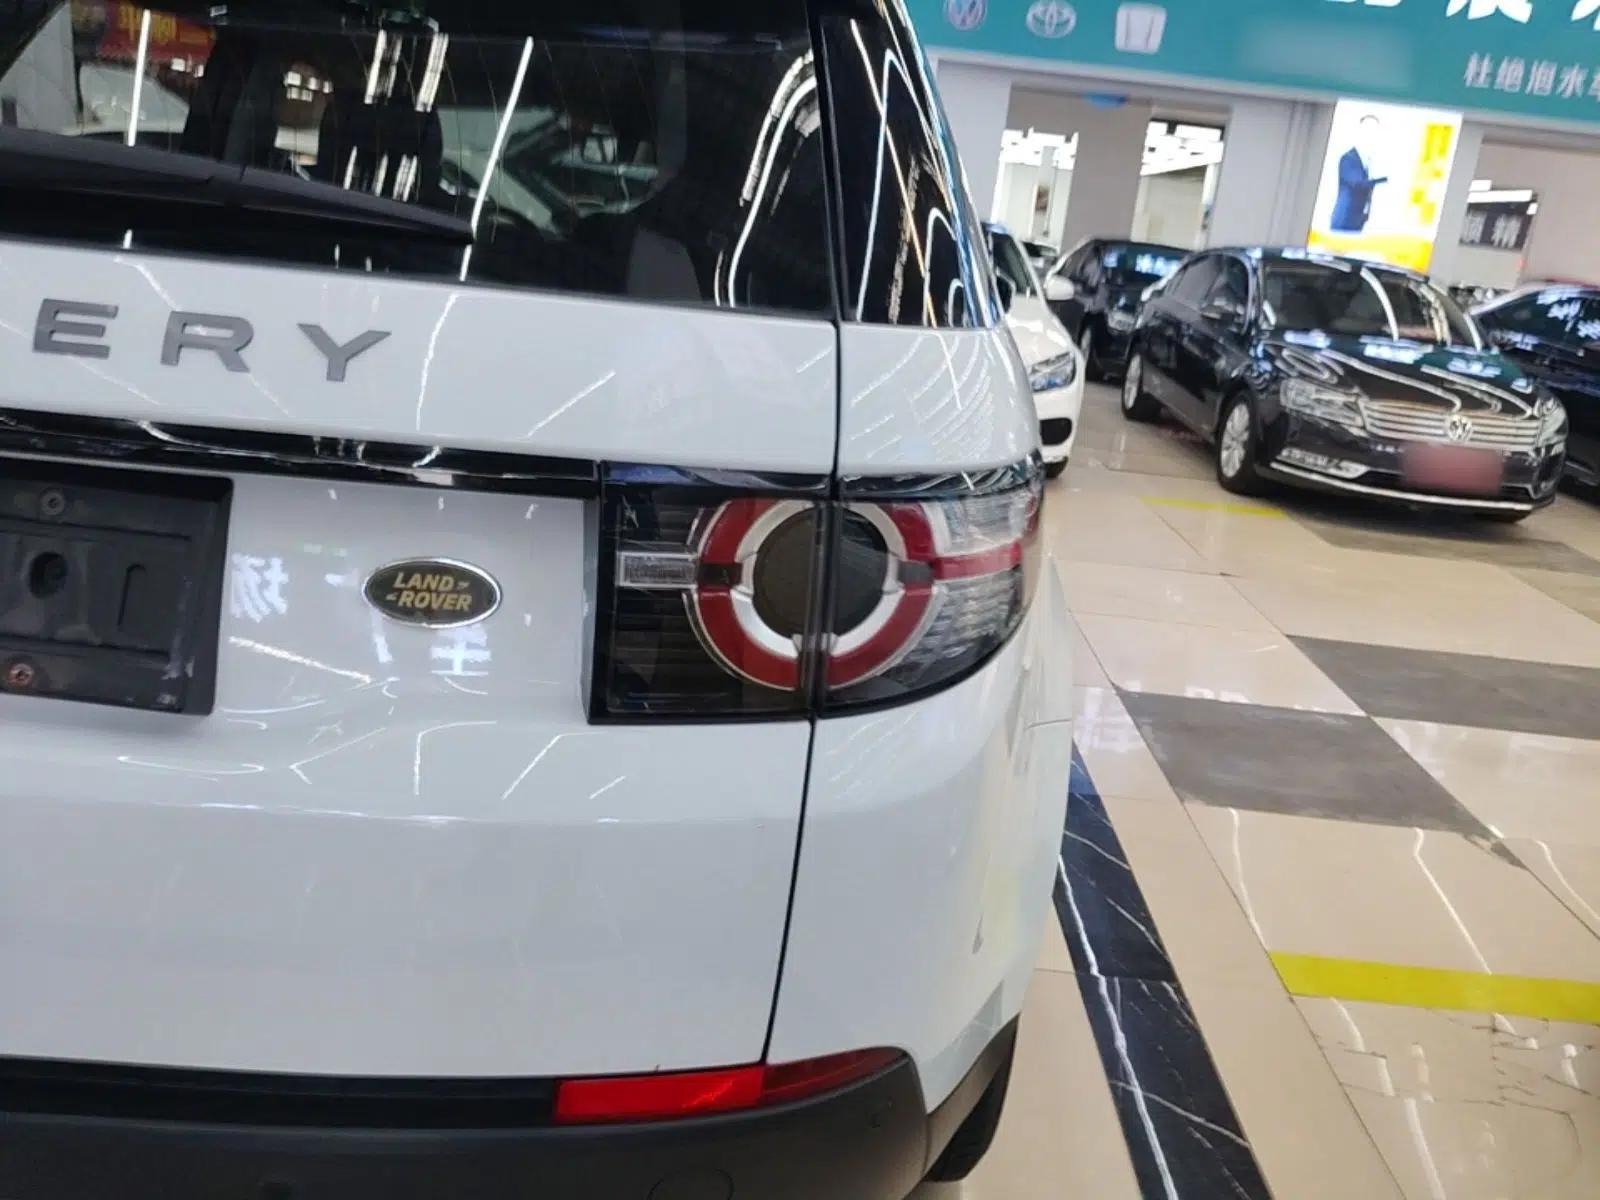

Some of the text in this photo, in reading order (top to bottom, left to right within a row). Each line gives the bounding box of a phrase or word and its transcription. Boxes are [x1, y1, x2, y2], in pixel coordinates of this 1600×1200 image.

[33, 298, 392, 383] ERY
[392, 571, 455, 592] LAND
[397, 589, 473, 612] ROVER
